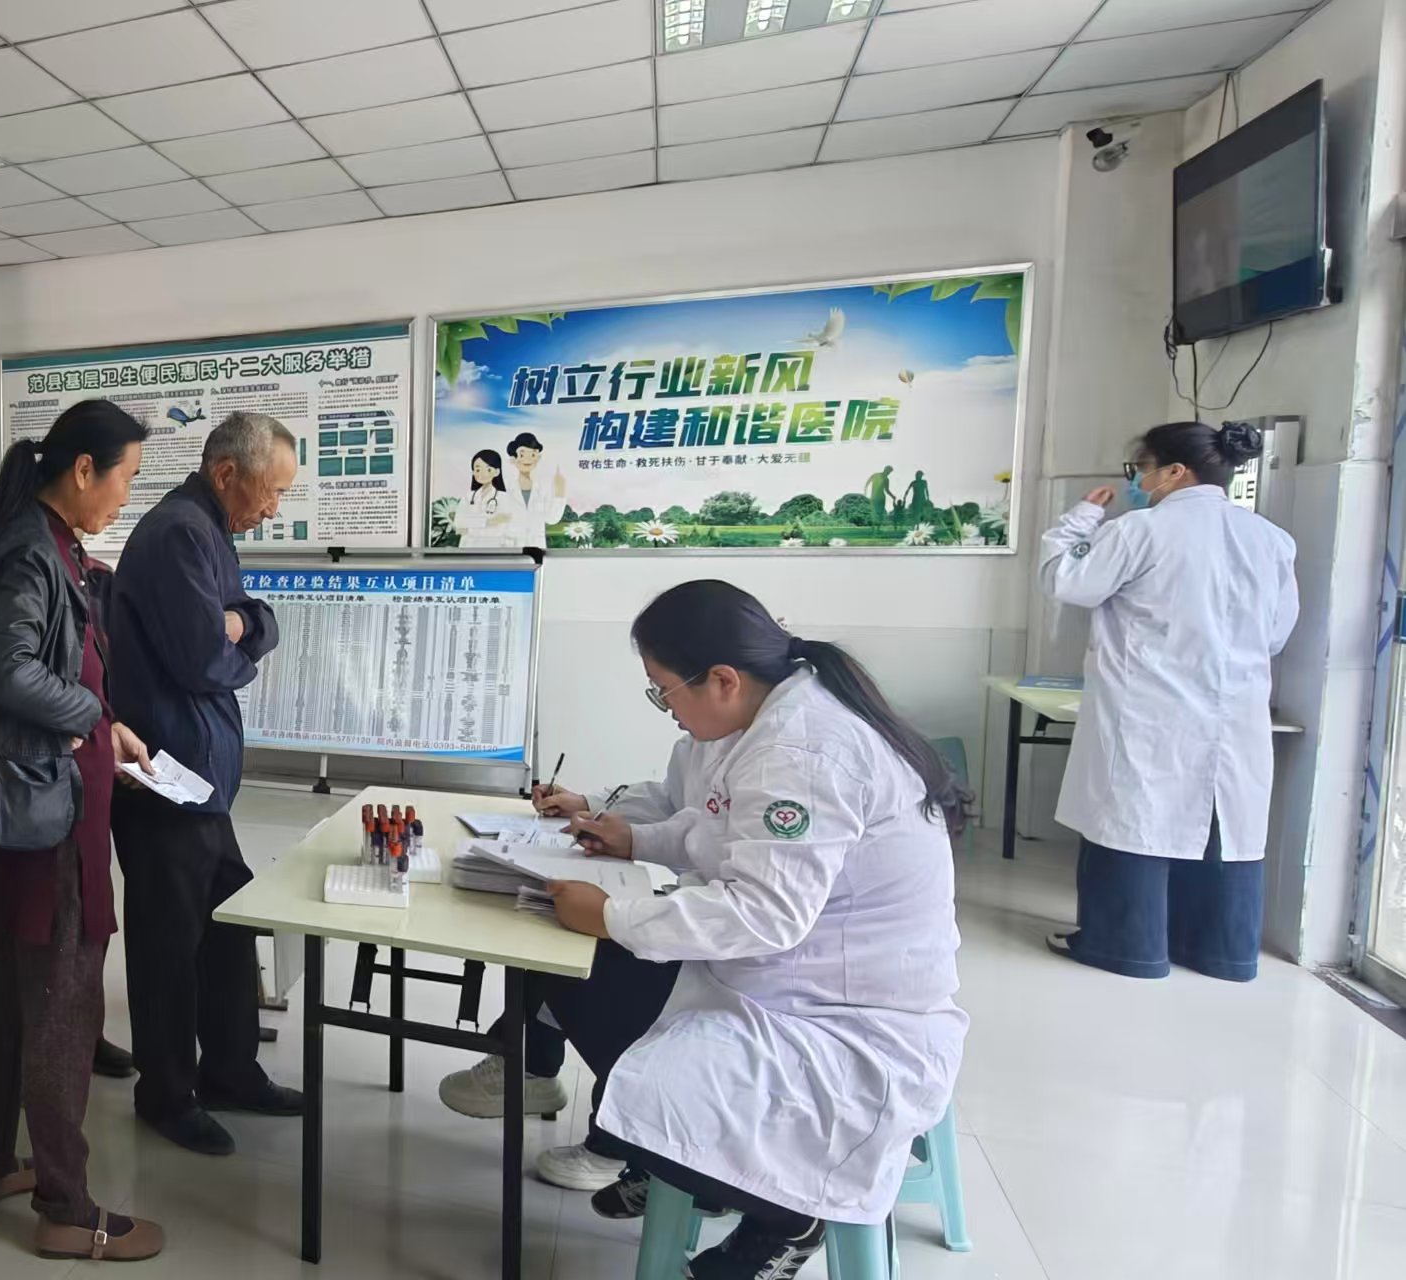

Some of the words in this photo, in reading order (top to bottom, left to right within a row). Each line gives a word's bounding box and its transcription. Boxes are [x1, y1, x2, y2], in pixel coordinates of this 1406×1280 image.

[28, 347, 372, 394] 范县基层卫生便民惠民十二大服务举措
[508, 350, 816, 407] 树立行业新风
[578, 397, 900, 451] 构建和谐医院
[242, 574, 477, 590] 省检查检验结果互认项目清单
